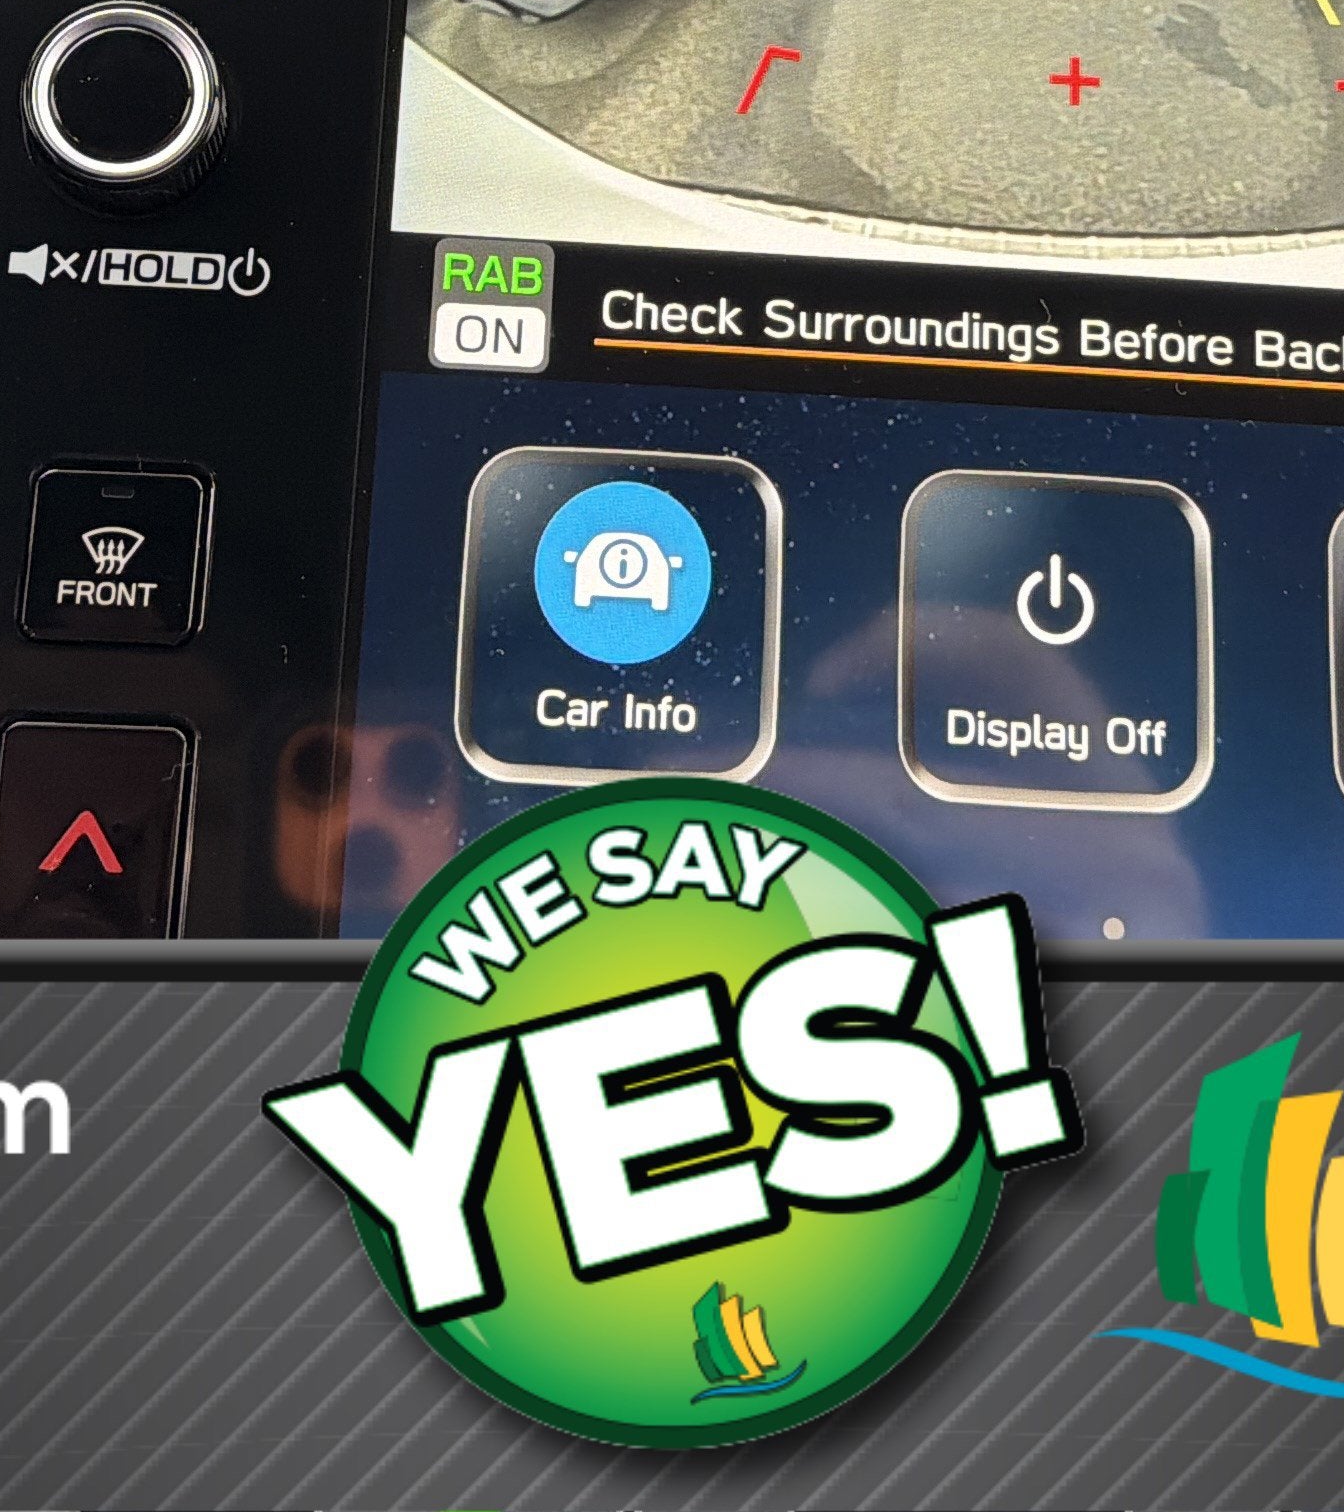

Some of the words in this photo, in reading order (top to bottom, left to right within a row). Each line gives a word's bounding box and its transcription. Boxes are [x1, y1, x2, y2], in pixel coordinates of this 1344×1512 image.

[441, 253, 545, 297] RAB
[455, 315, 523, 357] ON
[600, 292, 744, 340] Check
[763, 300, 1062, 361] Surroundings
[1079, 320, 1234, 368] Before
[57, 580, 157, 608] FRONT
[534, 690, 609, 733] Car
[624, 692, 697, 734] Info
[946, 708, 1091, 757] Display
[1106, 715, 1167, 756] Off
